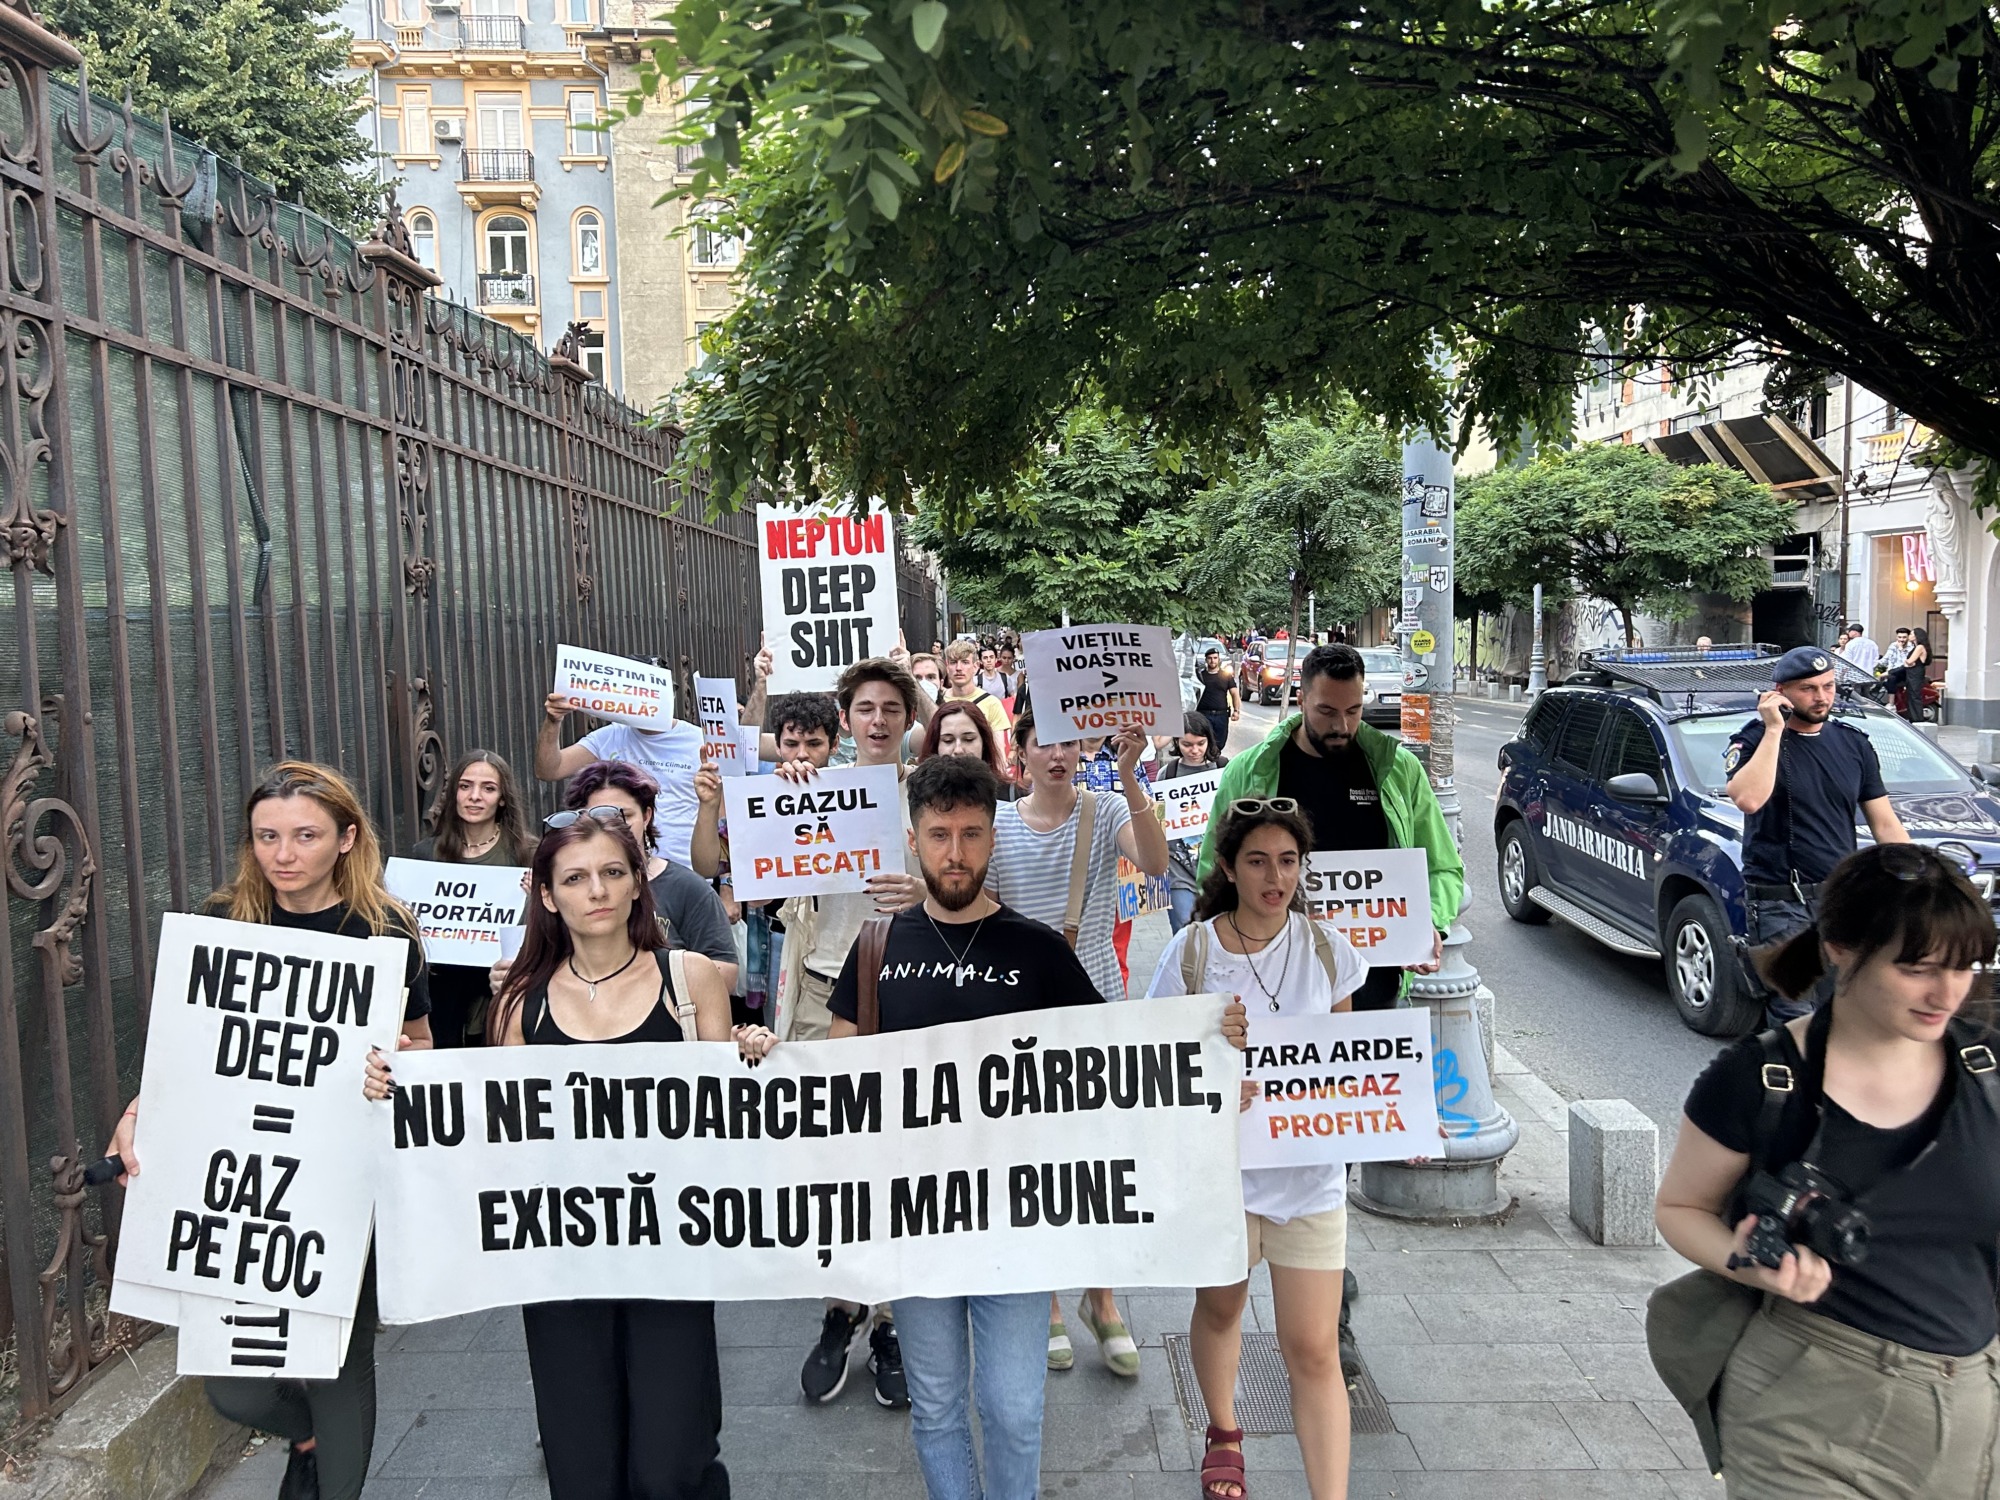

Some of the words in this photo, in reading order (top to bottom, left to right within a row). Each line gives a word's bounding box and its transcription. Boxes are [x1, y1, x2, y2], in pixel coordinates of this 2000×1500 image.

[766, 513, 885, 560] NEPTUN
[1902, 533, 1936, 583] RA
[782, 564, 876, 615] DEEP
[790, 617, 874, 668] SHIT
[1061, 632, 1142, 651] VIEȚILE
[563, 658, 646, 682] INVESTIM
[649, 673, 668, 687] ÎN
[1055, 652, 1153, 672] NOASTRE
[570, 674, 661, 699] ÎNCĂLZIRE
[569, 696, 659, 718] GLOBALĂ?
[1060, 692, 1162, 713] PROFITUL
[1072, 710, 1156, 731] VOSTRU
[665, 761, 692, 770] Climate
[747, 796, 767, 819] E
[775, 787, 878, 816] GAZUL
[1155, 791, 1165, 802] E
[1168, 780, 1219, 801] GAZUL
[1179, 797, 1201, 813] SĂ
[794, 815, 836, 845] SĂ
[1163, 811, 1210, 831] PLECA
[1542, 811, 1646, 881] JANDARMERIA
[754, 848, 881, 880] PLECAȚI
[434, 881, 477, 899] NOI
[1305, 869, 1383, 892] STOP
[1308, 897, 1408, 921] EPTUN
[419, 925, 500, 945] SECINȚEL
[1338, 926, 1388, 949] EP
[187, 944, 375, 1027] NEPTUN
[214, 1014, 340, 1088] DEEP
[1240, 1042, 1322, 1077] ȚARA
[1329, 1037, 1424, 1063] ARDE,
[394, 1081, 465, 1149] NU
[485, 1077, 555, 1143] NE
[564, 1071, 882, 1141] ÎNTOARCEM
[901, 1061, 963, 1130] LA
[978, 1035, 1223, 1119] CĂRBUNE,
[1264, 1072, 1402, 1102] ROMGAZ
[1268, 1101, 1406, 1140] PROFITĂ
[203, 1148, 302, 1223] GAZ
[478, 1171, 662, 1252] EXISTĂ
[678, 1181, 871, 1269] SOLUȚII
[890, 1168, 989, 1239] MAI
[1008, 1158, 1155, 1228] BUNE.
[166, 1209, 229, 1280] PE
[233, 1221, 326, 1299] FOC
